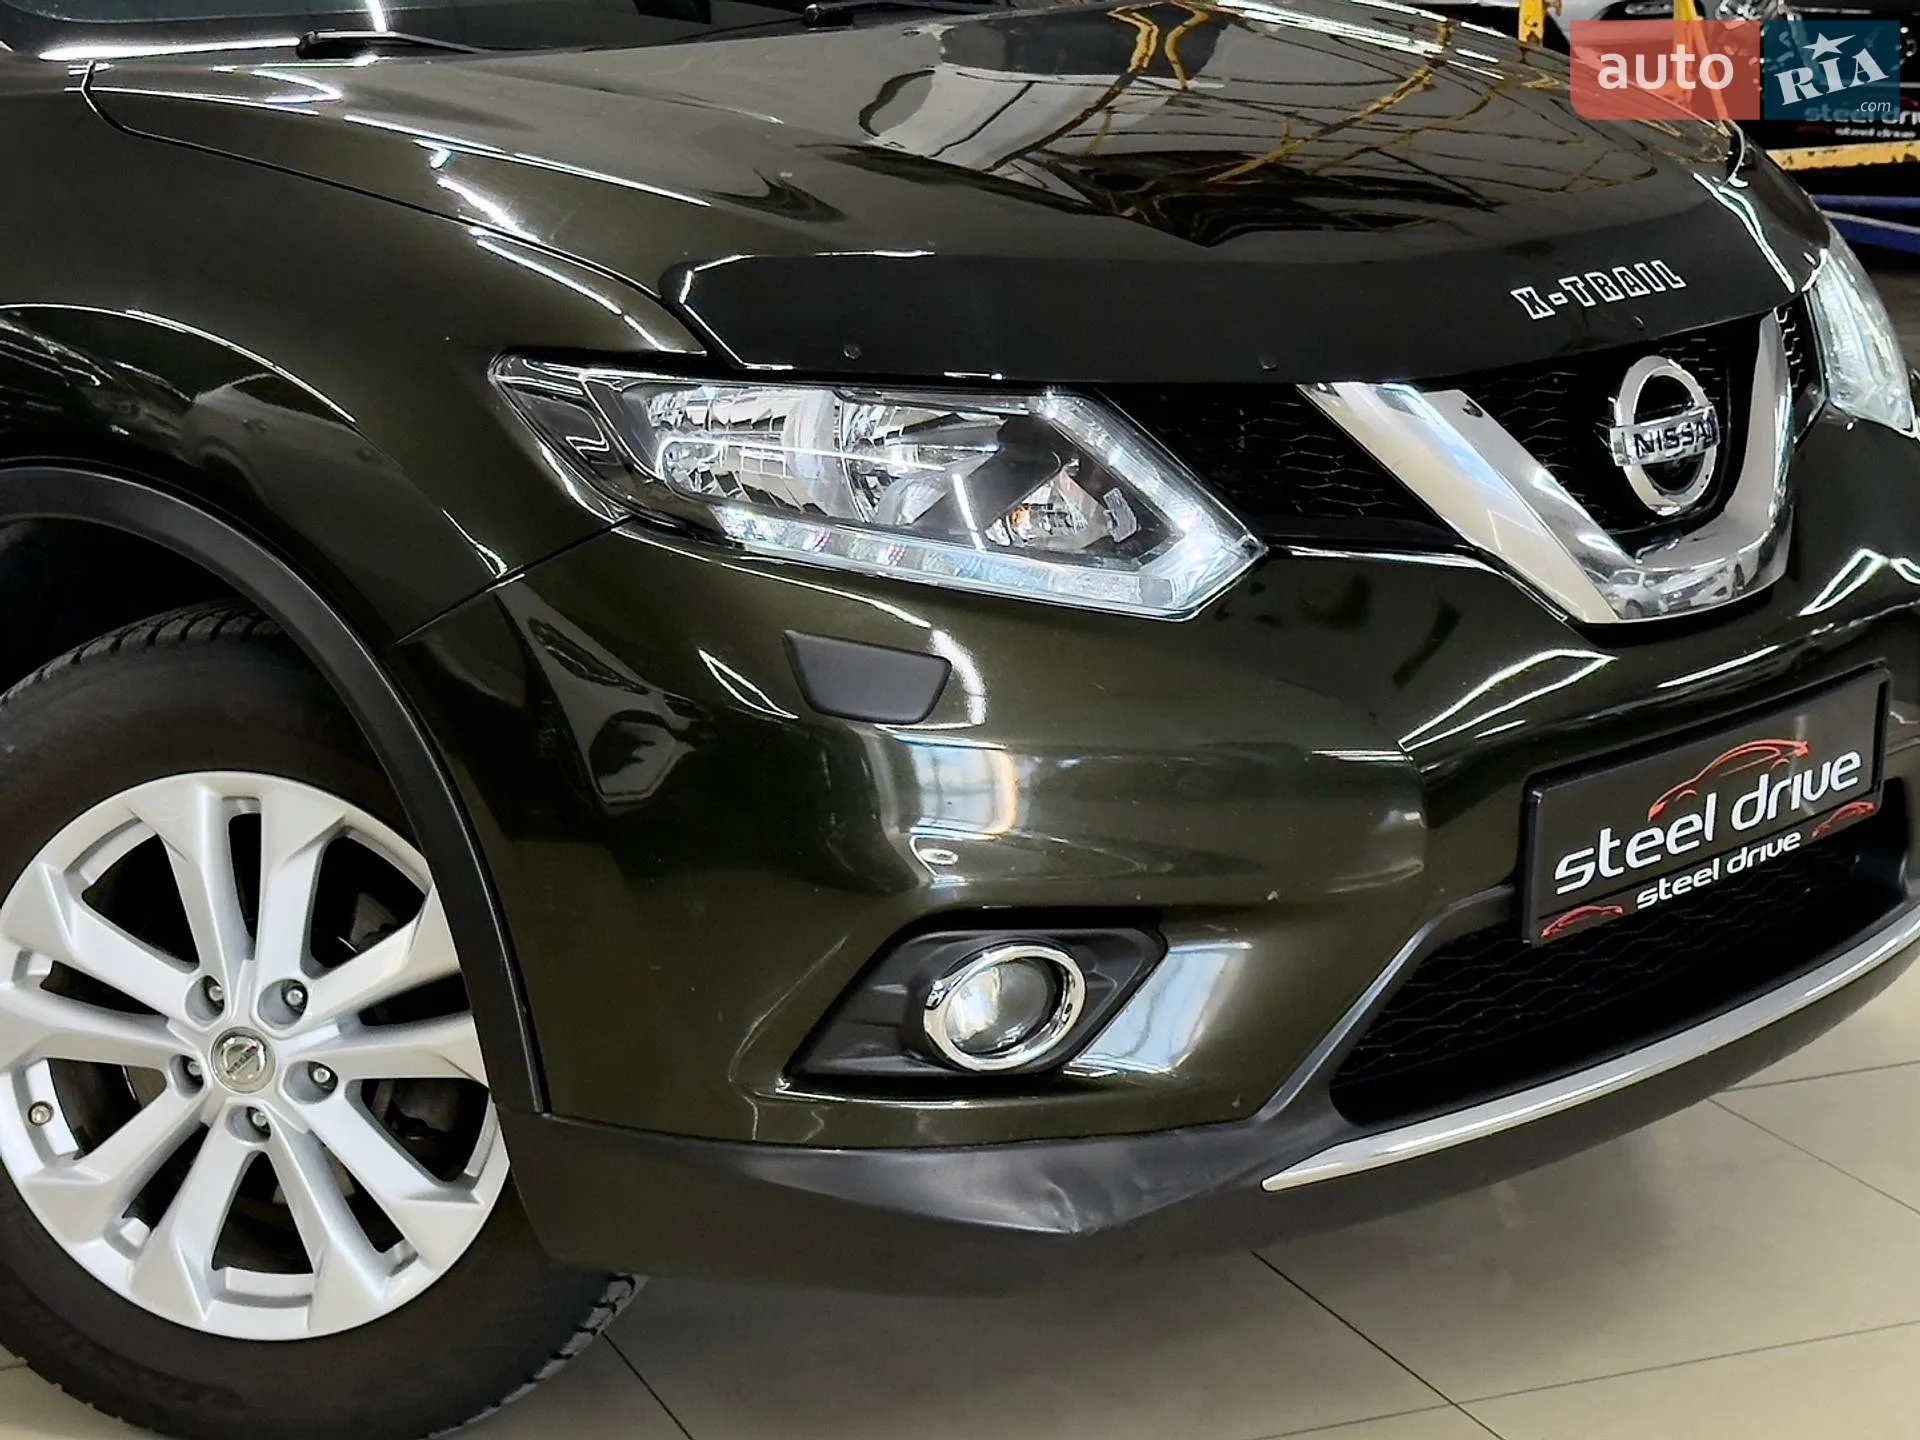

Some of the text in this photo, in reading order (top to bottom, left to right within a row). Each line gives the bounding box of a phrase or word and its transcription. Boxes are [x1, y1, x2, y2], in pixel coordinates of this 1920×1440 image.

[1510, 259, 1687, 320] X-TRAIL
[1554, 750, 1861, 895] steel drive
[1637, 832, 1801, 910] steel drive
